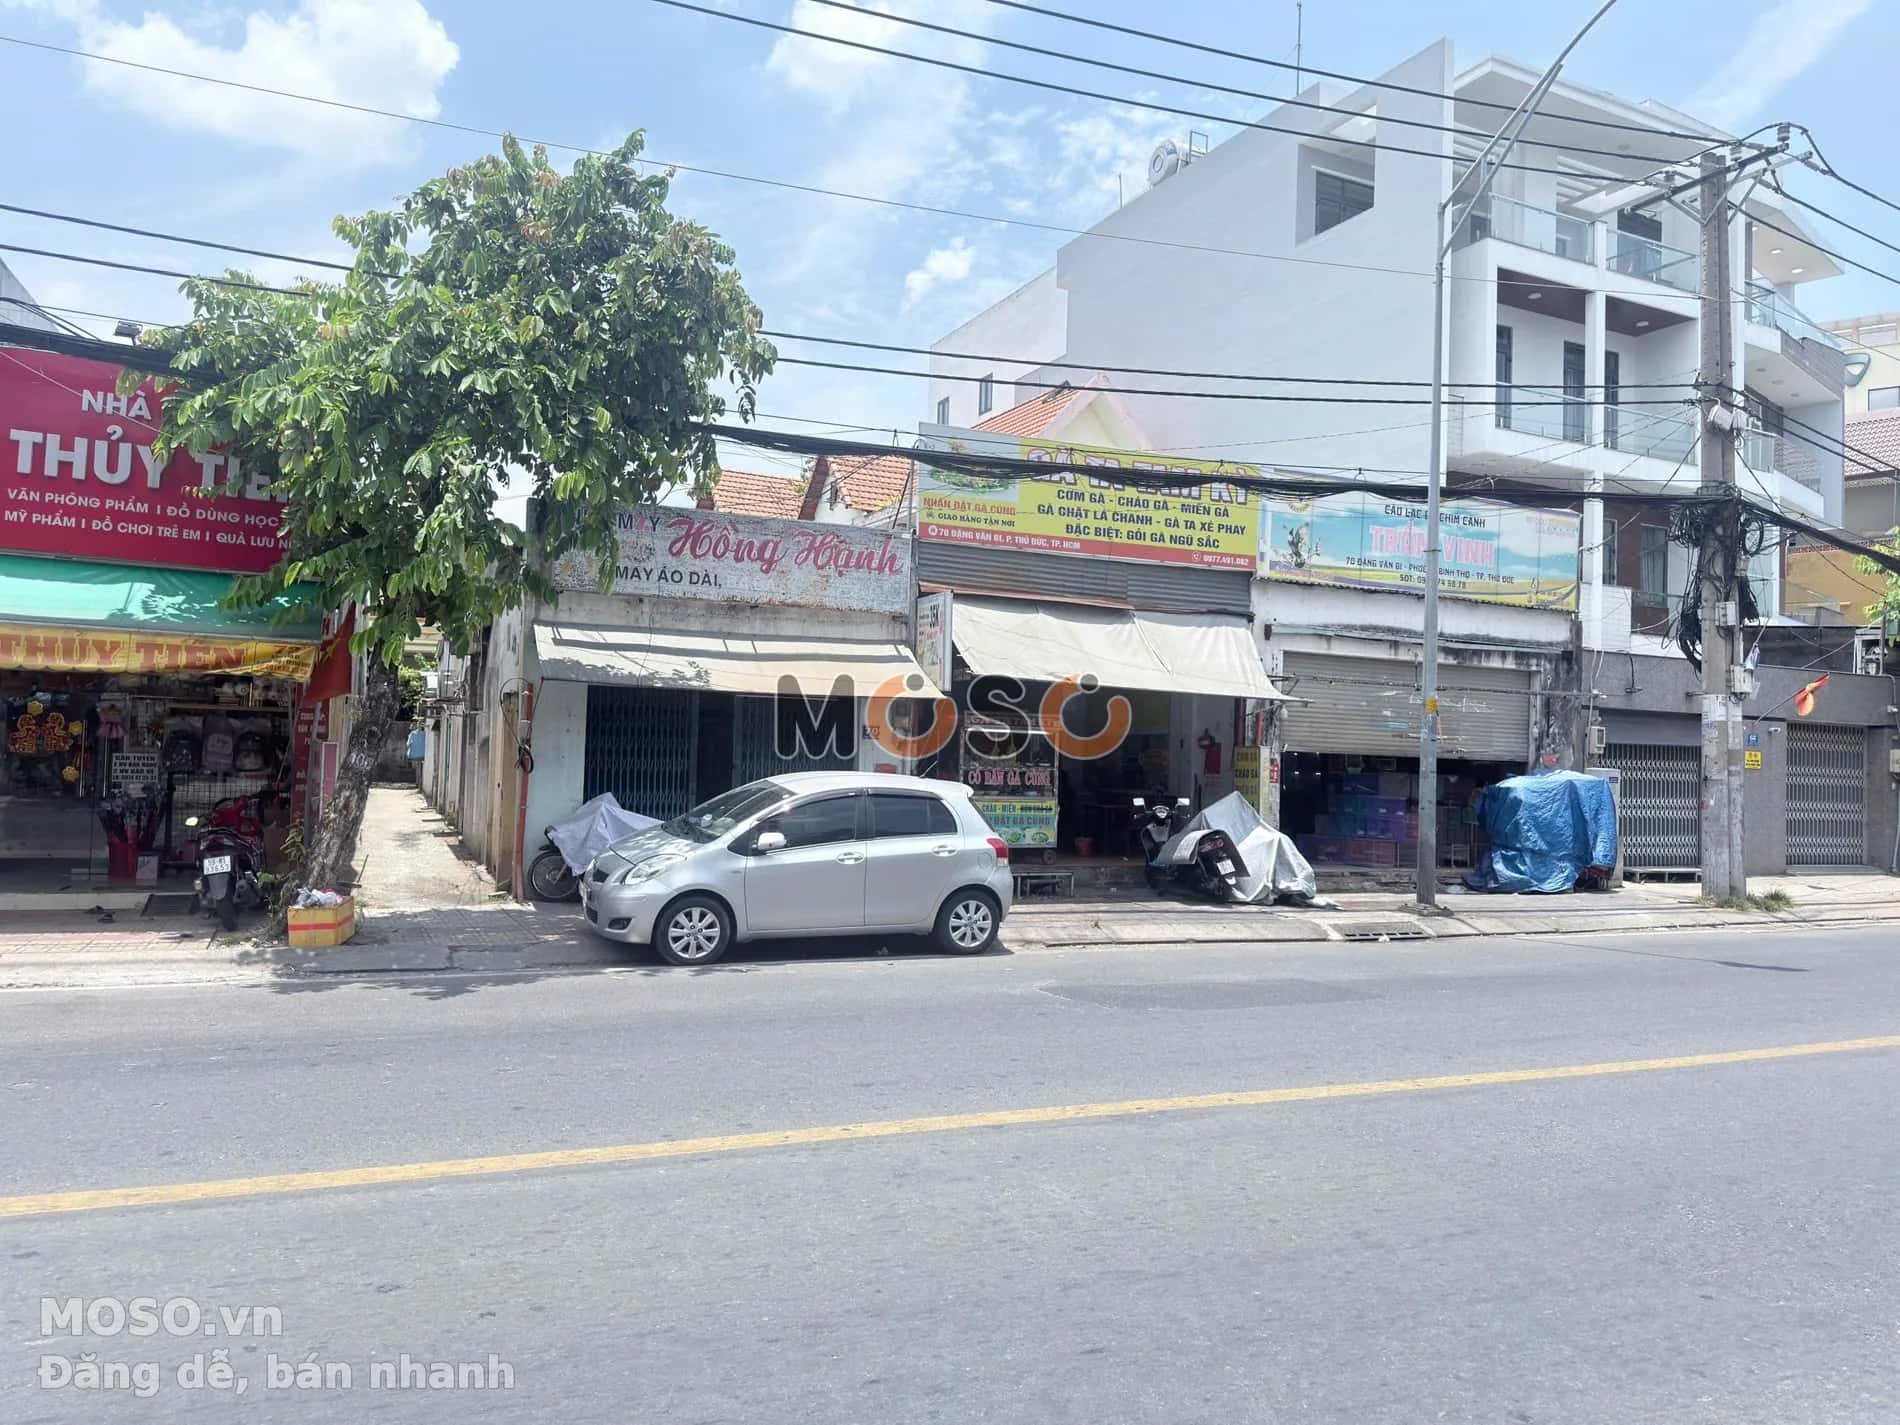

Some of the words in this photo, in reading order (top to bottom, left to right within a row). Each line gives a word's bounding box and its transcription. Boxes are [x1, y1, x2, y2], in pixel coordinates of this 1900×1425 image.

[81, 389, 153, 420] NHÀ
[10, 425, 174, 489] THỦY
[8, 488, 40, 502] VĂN
[45, 493, 100, 508] PHÒNG
[105, 496, 149, 514] PHẨM
[166, 502, 190, 518] ĐỒ
[196, 508, 240, 523] DÙNG
[245, 514, 279, 529] HỌC
[938, 512, 958, 521] GIAO
[1057, 488, 1085, 502] CƠM
[1089, 491, 1105, 505] GÀ
[1118, 496, 1149, 510] CHÁO
[1153, 499, 1169, 511] GÀ
[1214, 504, 1230, 518] GÀ
[4, 510, 28, 523] MỸ
[32, 510, 76, 529] PHẨM
[92, 516, 113, 532] ĐỒ
[117, 523, 153, 536] CHƠI
[157, 524, 179, 539] TRẺ
[183, 529, 200, 541] EM
[251, 535, 275, 549] LƯU
[1037, 503, 1054, 516] GÀ
[1058, 505, 1089, 520] CHẶT
[1093, 508, 1108, 521] LÁ
[1112, 511, 1152, 526] CHANH
[1165, 515, 1180, 529] GÀ
[1184, 519, 1196, 531] TA
[1200, 519, 1214, 533] XÉ
[1218, 523, 1247, 536] PHAY
[668, 515, 789, 575] Hồng
[793, 528, 904, 578] Hạnh
[1066, 524, 1090, 538] ĐẶC
[1094, 525, 1122, 540] BIỆT:
[1150, 531, 1166, 544] GÀ
[1169, 533, 1193, 546] NGŨ
[1197, 536, 1220, 549] SẮC
[1442, 535, 1497, 567] VINH
[615, 565, 653, 583] MAY
[657, 565, 684, 584] ÁO
